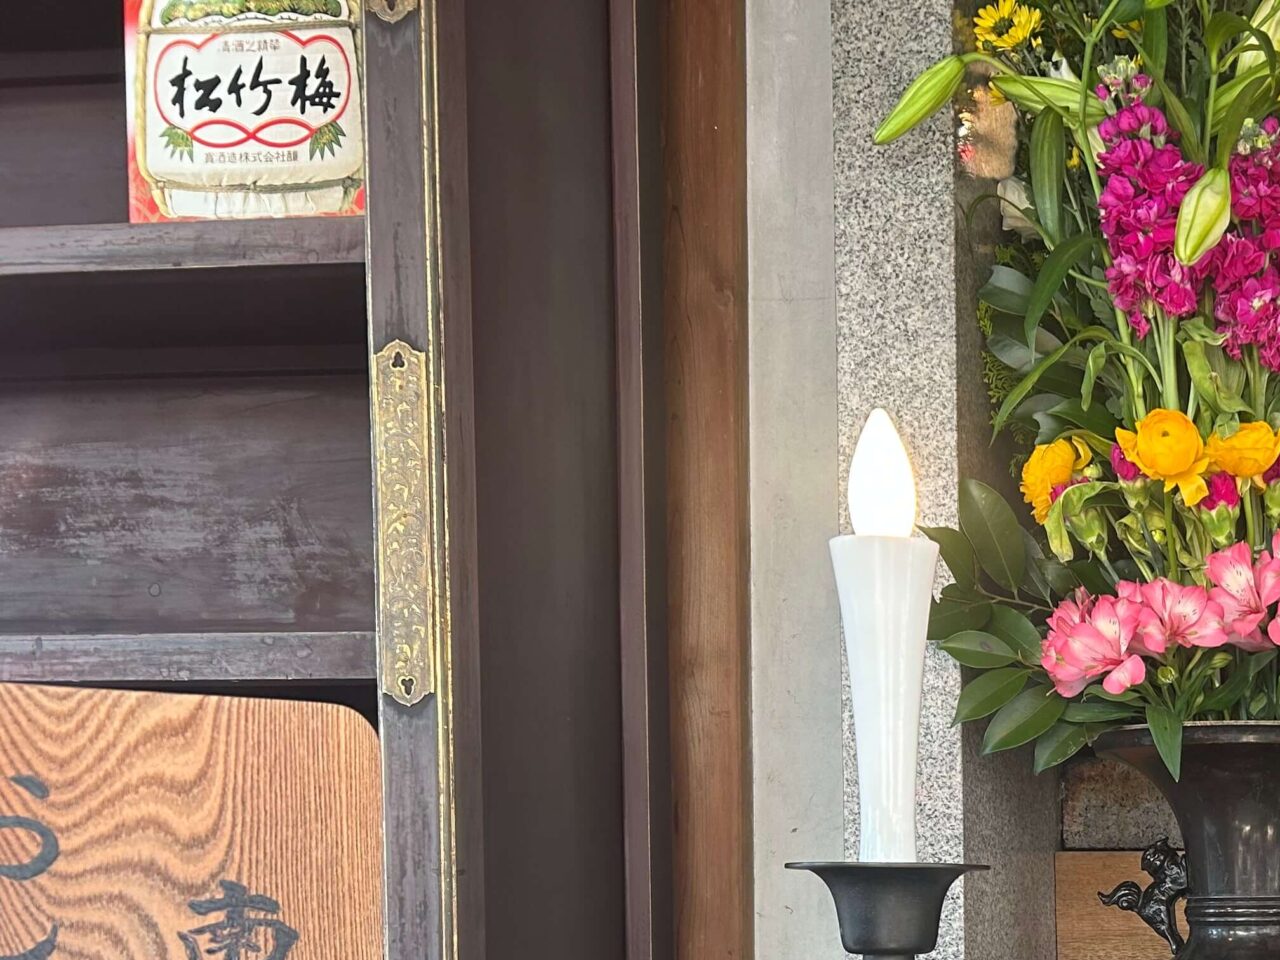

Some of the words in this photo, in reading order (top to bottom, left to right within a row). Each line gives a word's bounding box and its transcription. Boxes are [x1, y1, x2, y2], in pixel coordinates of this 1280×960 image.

[168, 54, 342, 119] 松竹梅
[204, 150, 299, 164] 酒造株式会社
